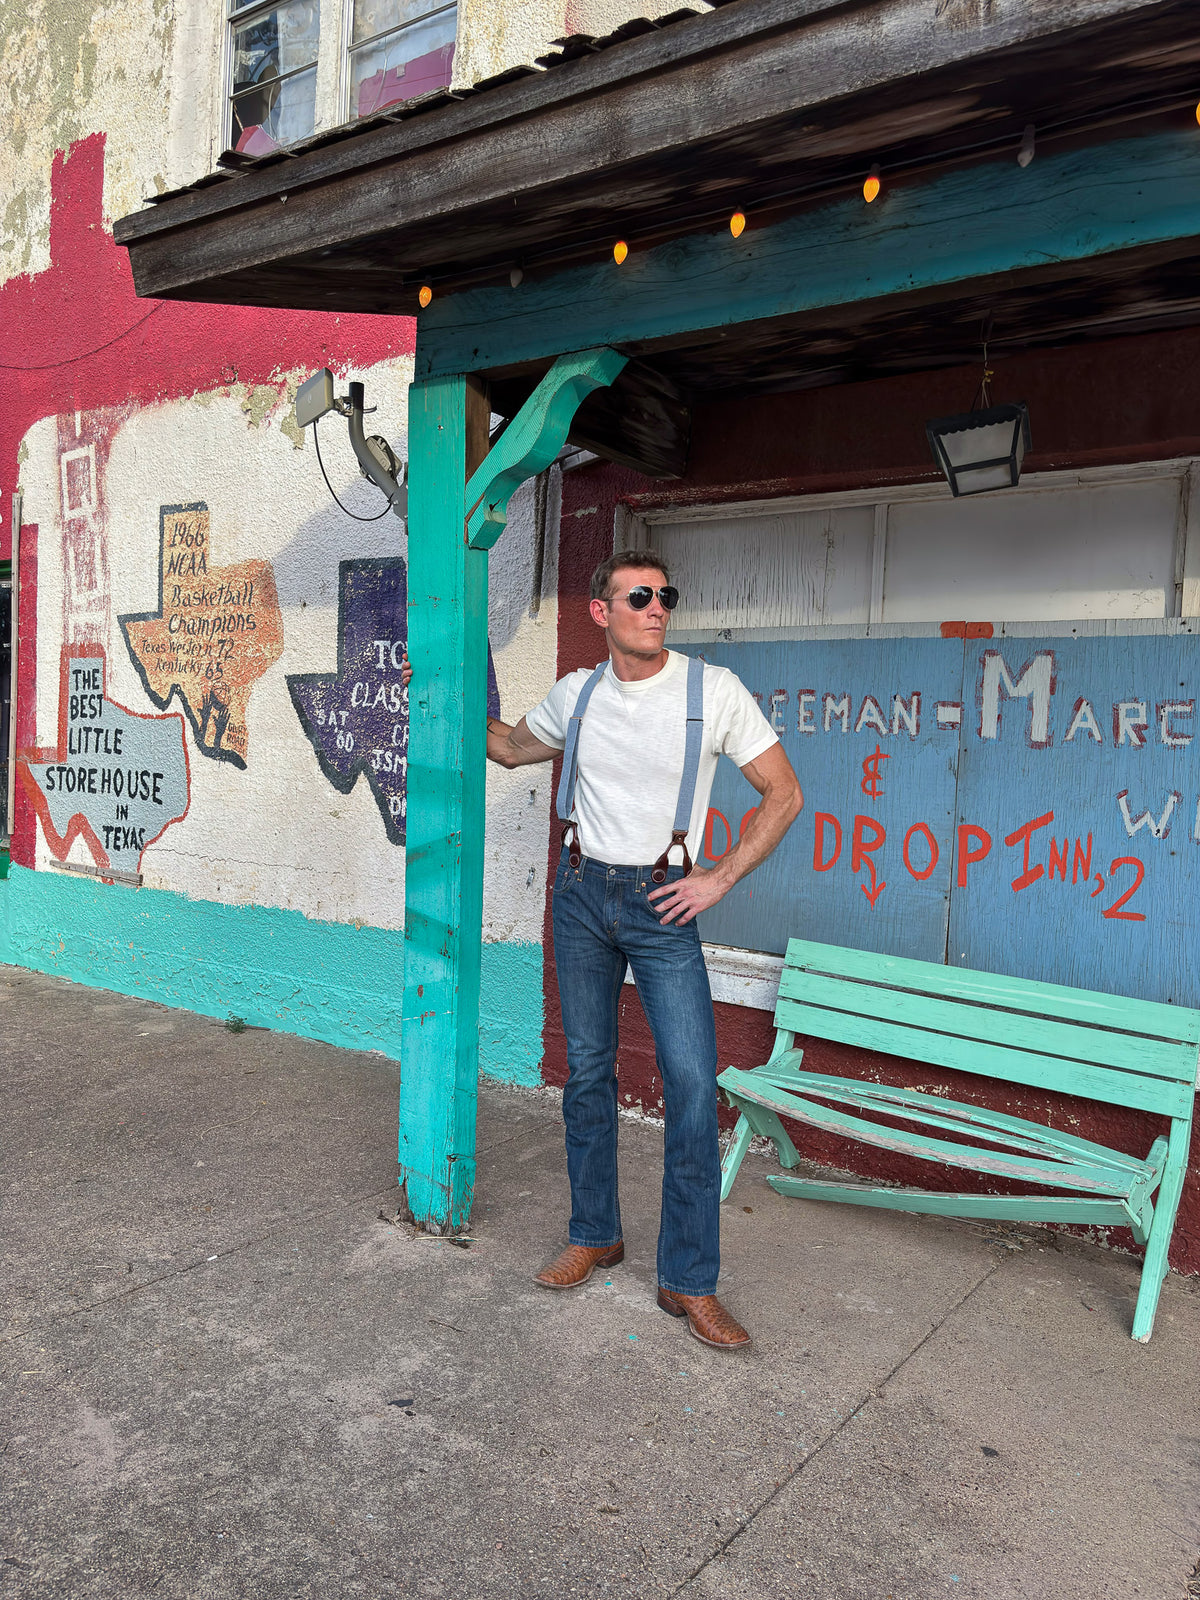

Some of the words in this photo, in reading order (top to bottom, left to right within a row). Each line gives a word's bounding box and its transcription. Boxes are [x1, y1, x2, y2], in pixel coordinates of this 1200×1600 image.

[169, 521, 205, 548] 1966
[167, 551, 207, 576] NCAA
[170, 581, 254, 608] Basketball
[168, 608, 257, 642] Champions
[141, 639, 166, 654] Texas
[217, 637, 236, 661] 72
[373, 640, 408, 670] TC
[72, 668, 100, 691] THE
[205, 660, 224, 681] 65
[70, 693, 104, 721] BEST
[316, 709, 350, 726] SAT
[68, 726, 123, 755] LITTLE
[116, 804, 128, 820] IN
[102, 825, 146, 851] TEXAS
[813, 810, 993, 889] DROP
